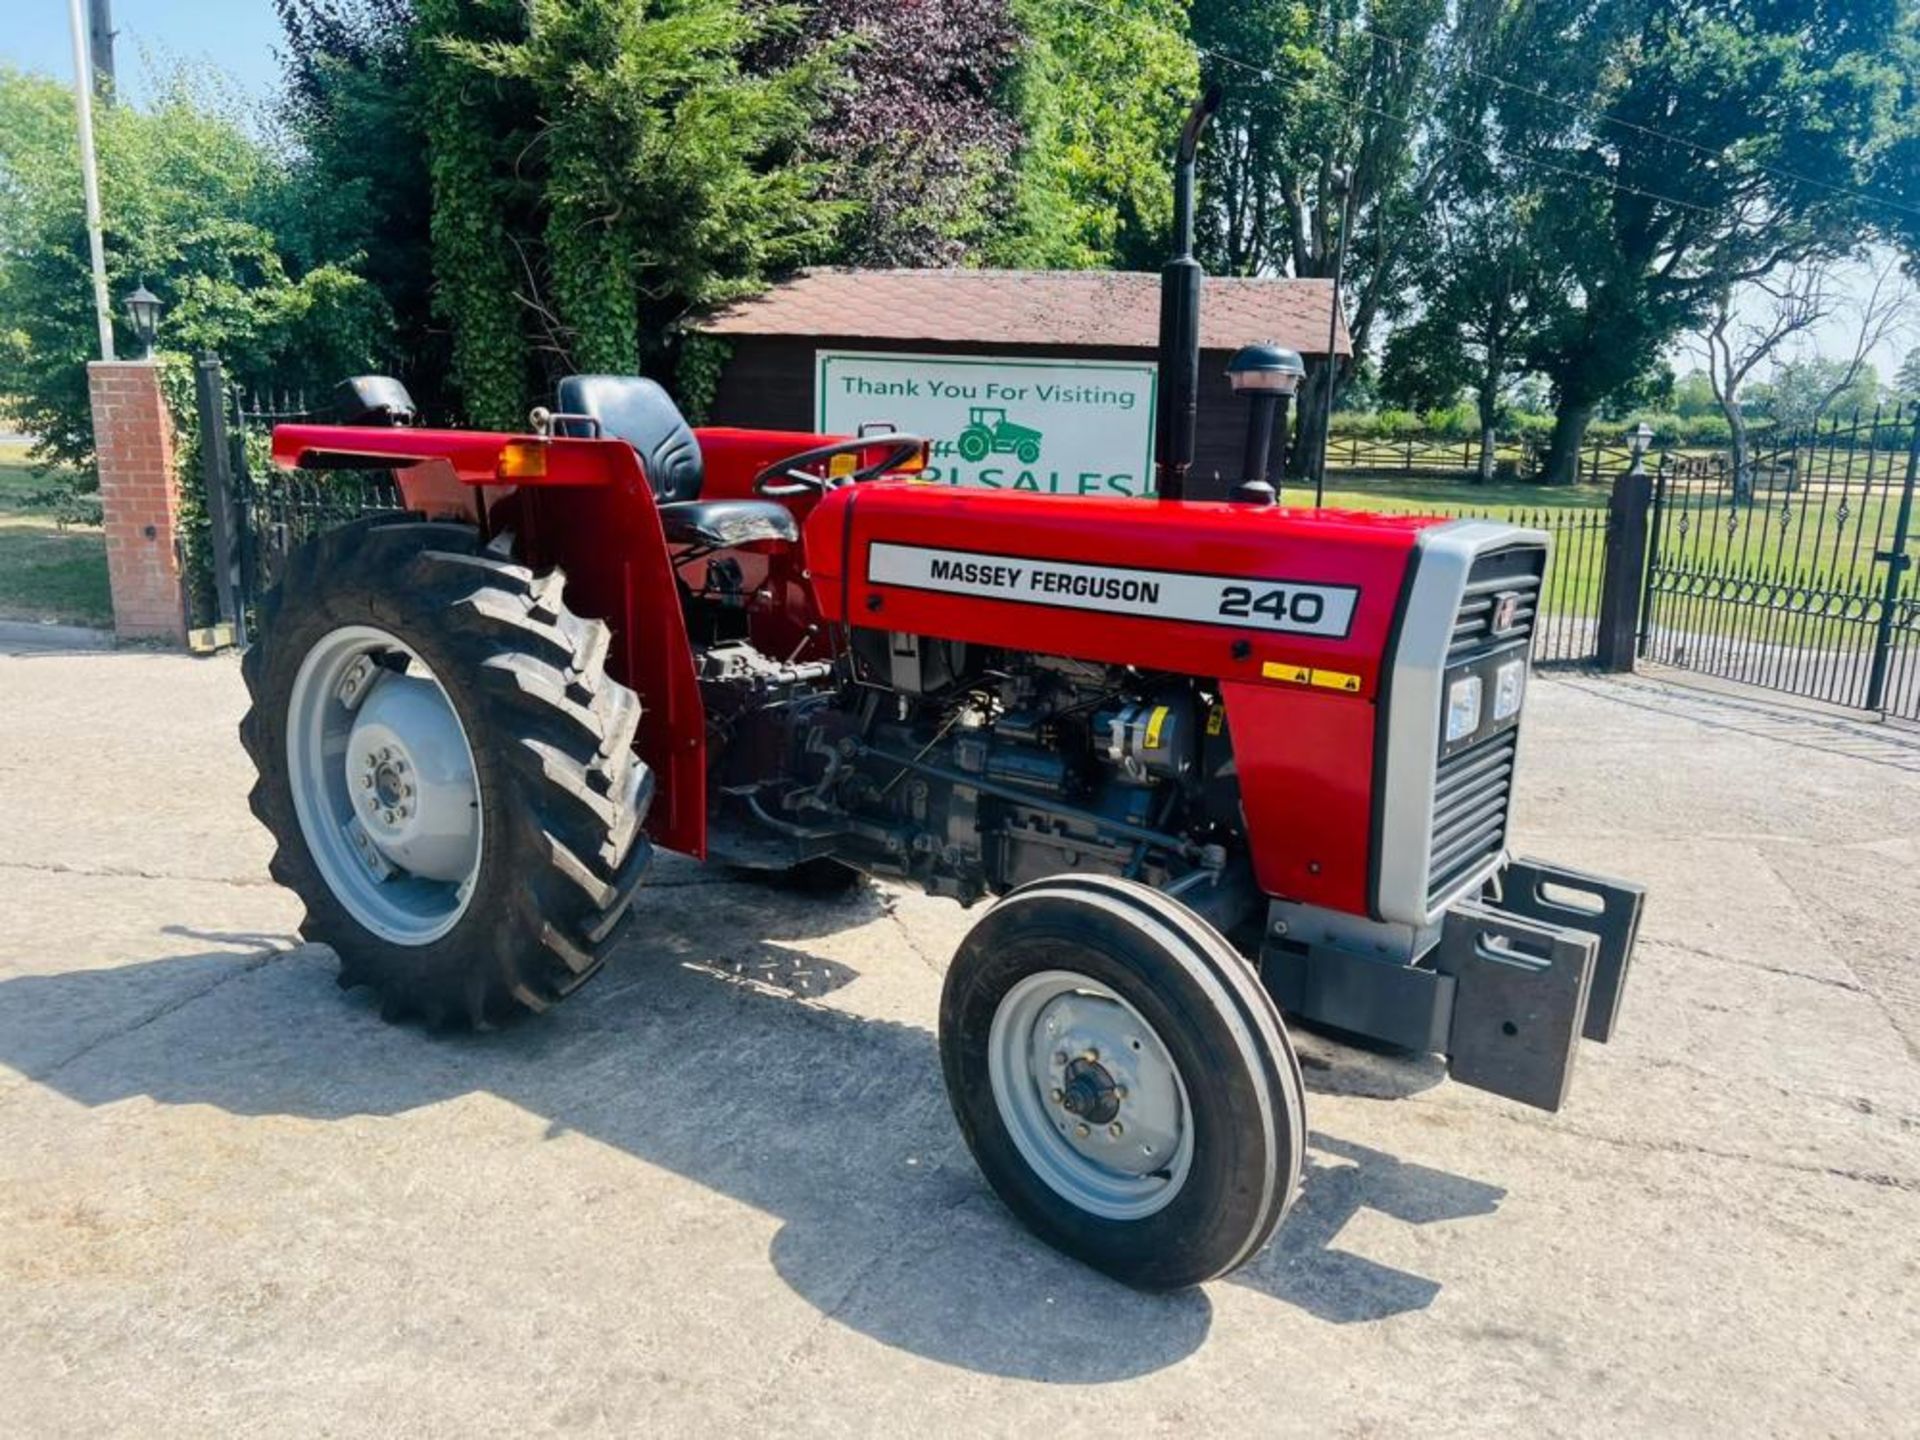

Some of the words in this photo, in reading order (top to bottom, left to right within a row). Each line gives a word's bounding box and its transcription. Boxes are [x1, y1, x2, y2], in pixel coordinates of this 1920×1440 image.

[841, 376, 919, 397] Thank
[927, 380, 976, 399] You
[986, 383, 1028, 401] For
[1036, 384, 1136, 410] Visiting
[930, 559, 1022, 588] MASSEY
[1030, 570, 1160, 604] FERGUSON
[1219, 586, 1325, 624] 240
